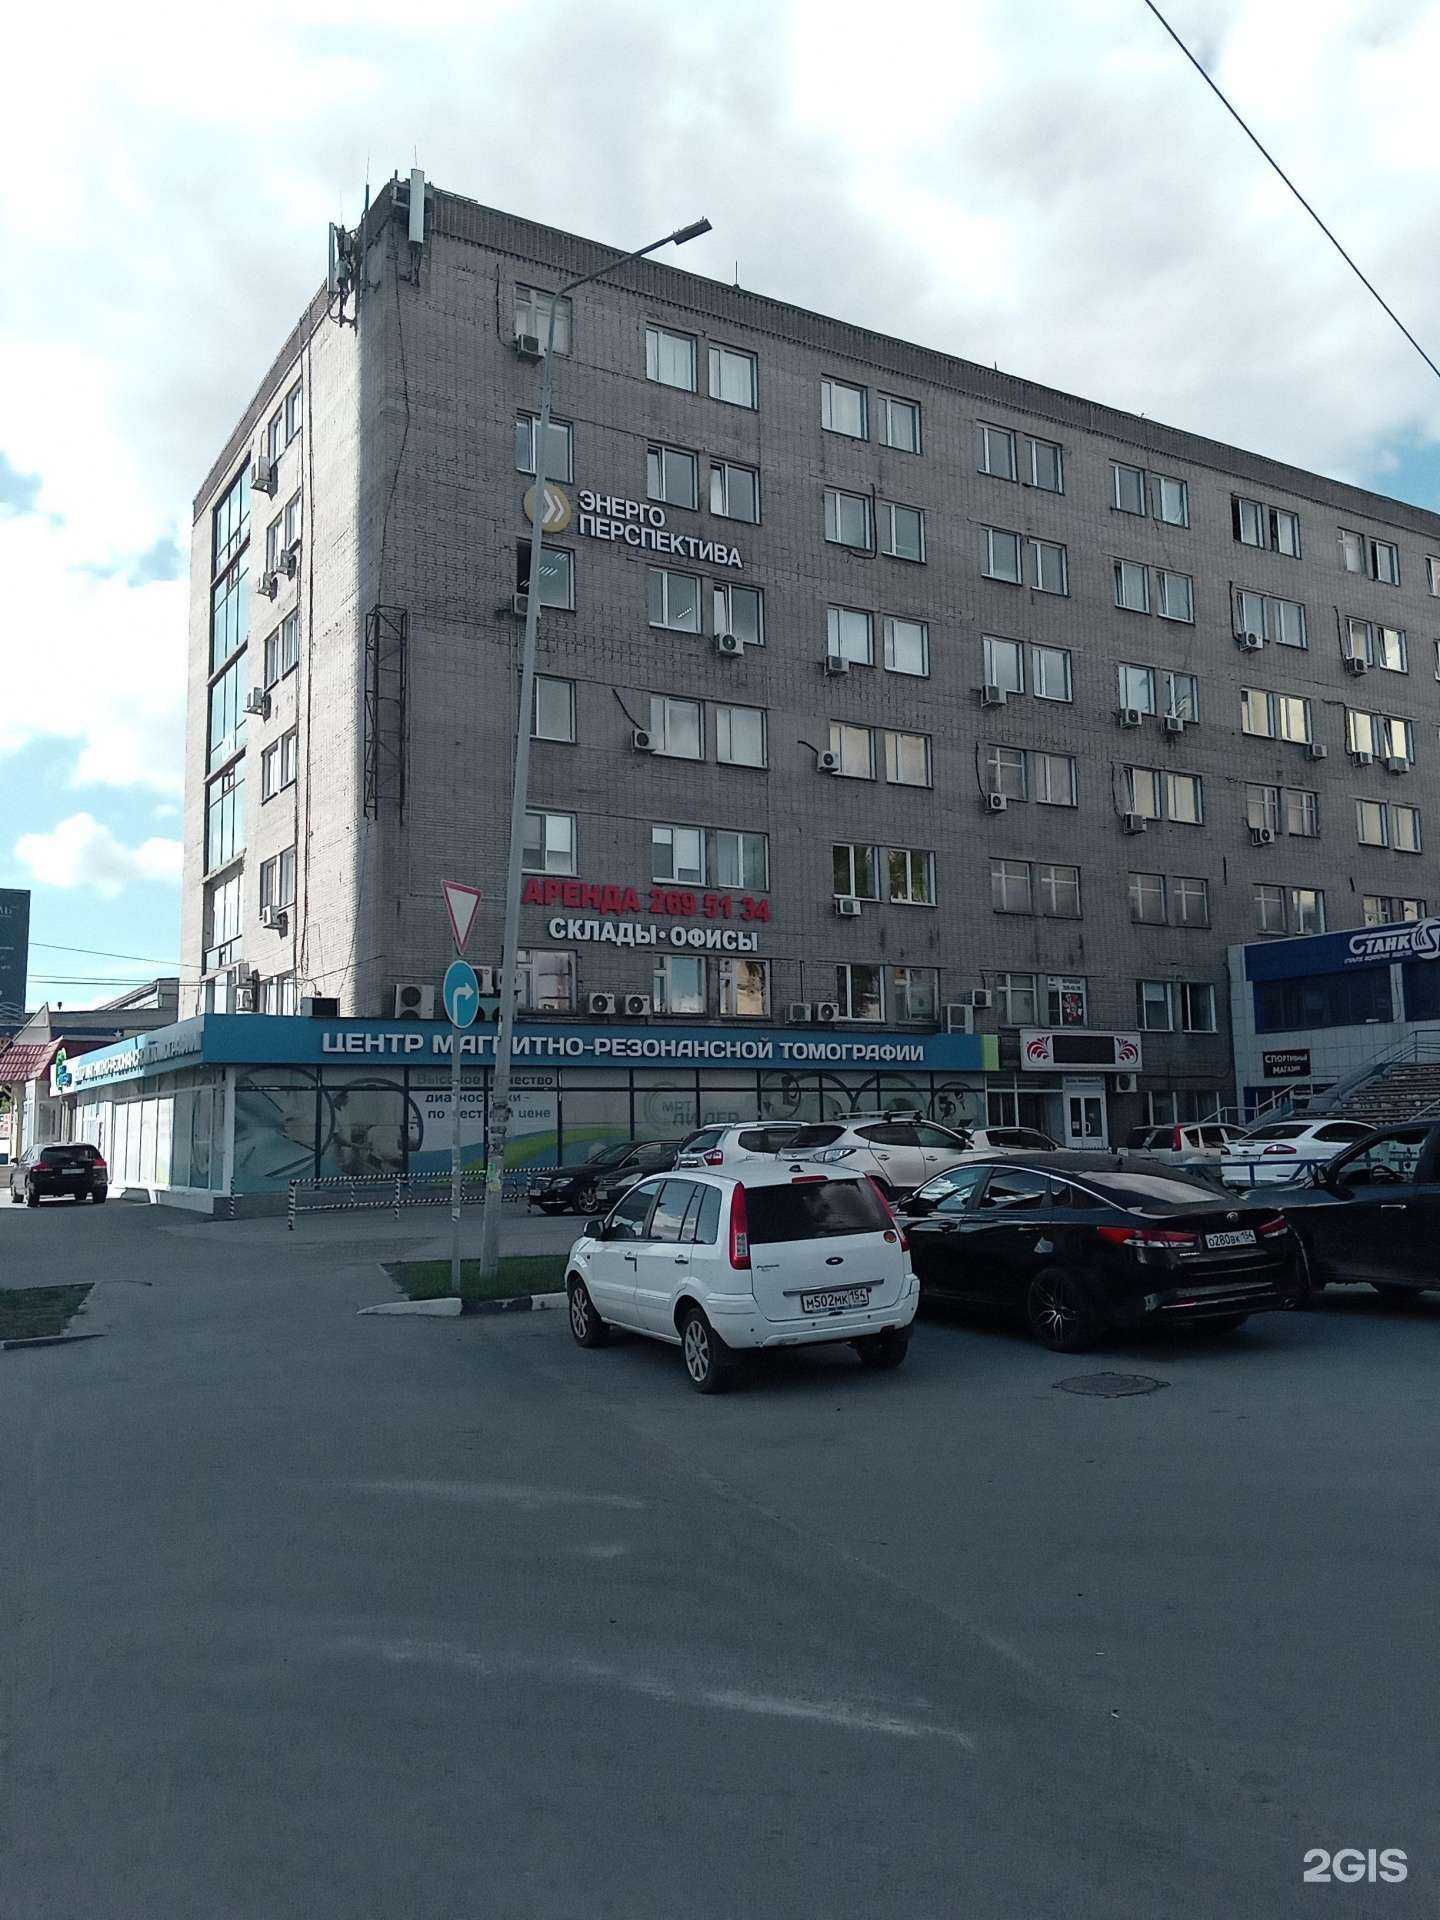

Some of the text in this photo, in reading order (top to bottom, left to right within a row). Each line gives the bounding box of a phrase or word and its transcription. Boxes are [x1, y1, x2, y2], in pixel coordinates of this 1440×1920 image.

[579, 489, 666, 527] ЭНЕРГО
[579, 514, 743, 568] ПЕРСПЕКТИВА
[523, 879, 772, 923] АРЕНДА 269 51 34
[671, 926, 758, 952] ОФИСЫ
[322, 1033, 424, 1053] ЦЕНТР
[780, 1041, 924, 1061] ТОМОГРАФИИ
[428, 1110, 445, 1119] по
[518, 1109, 551, 1119] цене
